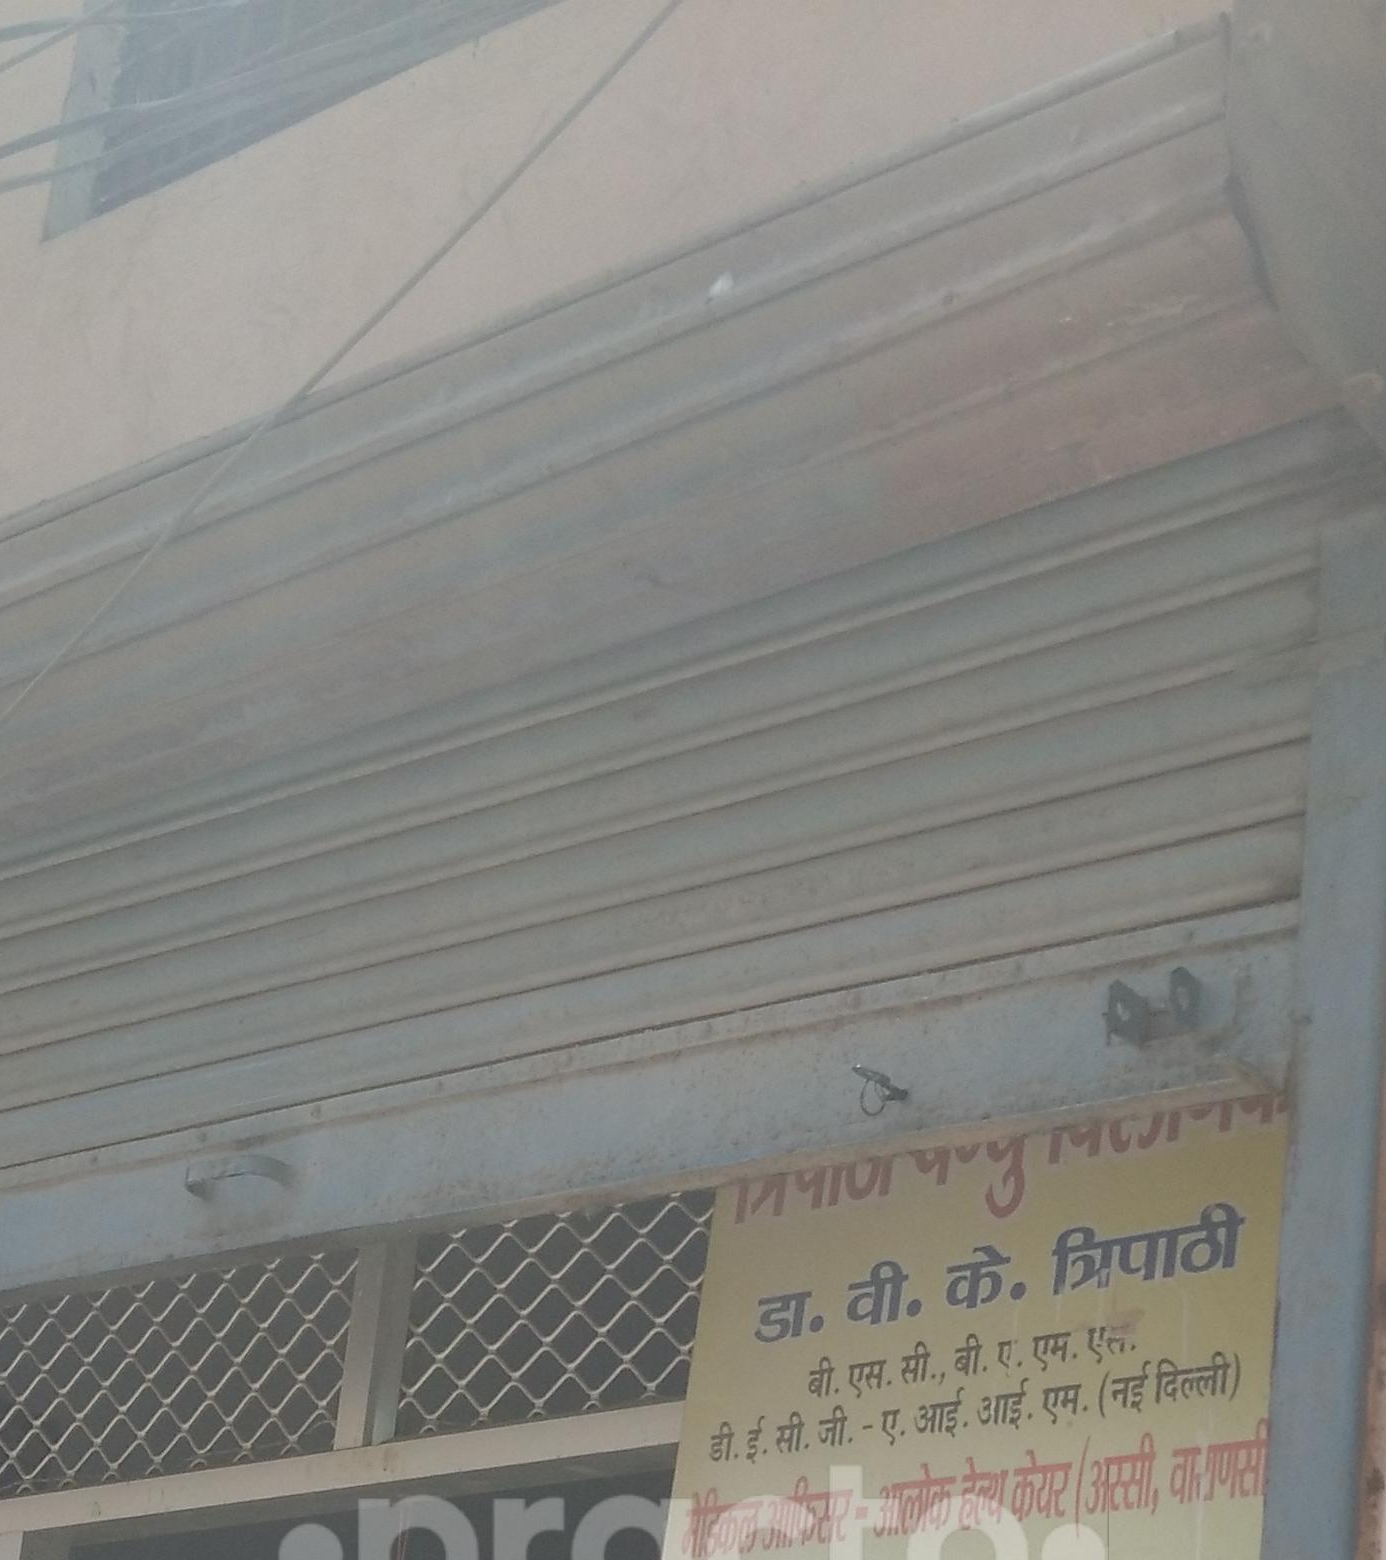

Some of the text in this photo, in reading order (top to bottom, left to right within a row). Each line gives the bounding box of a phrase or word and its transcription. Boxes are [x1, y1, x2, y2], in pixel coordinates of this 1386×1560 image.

[755, 1202, 1246, 1343] डा. वी. के. त्रिपाठी
[1012, 1449, 1073, 1522] केयर
